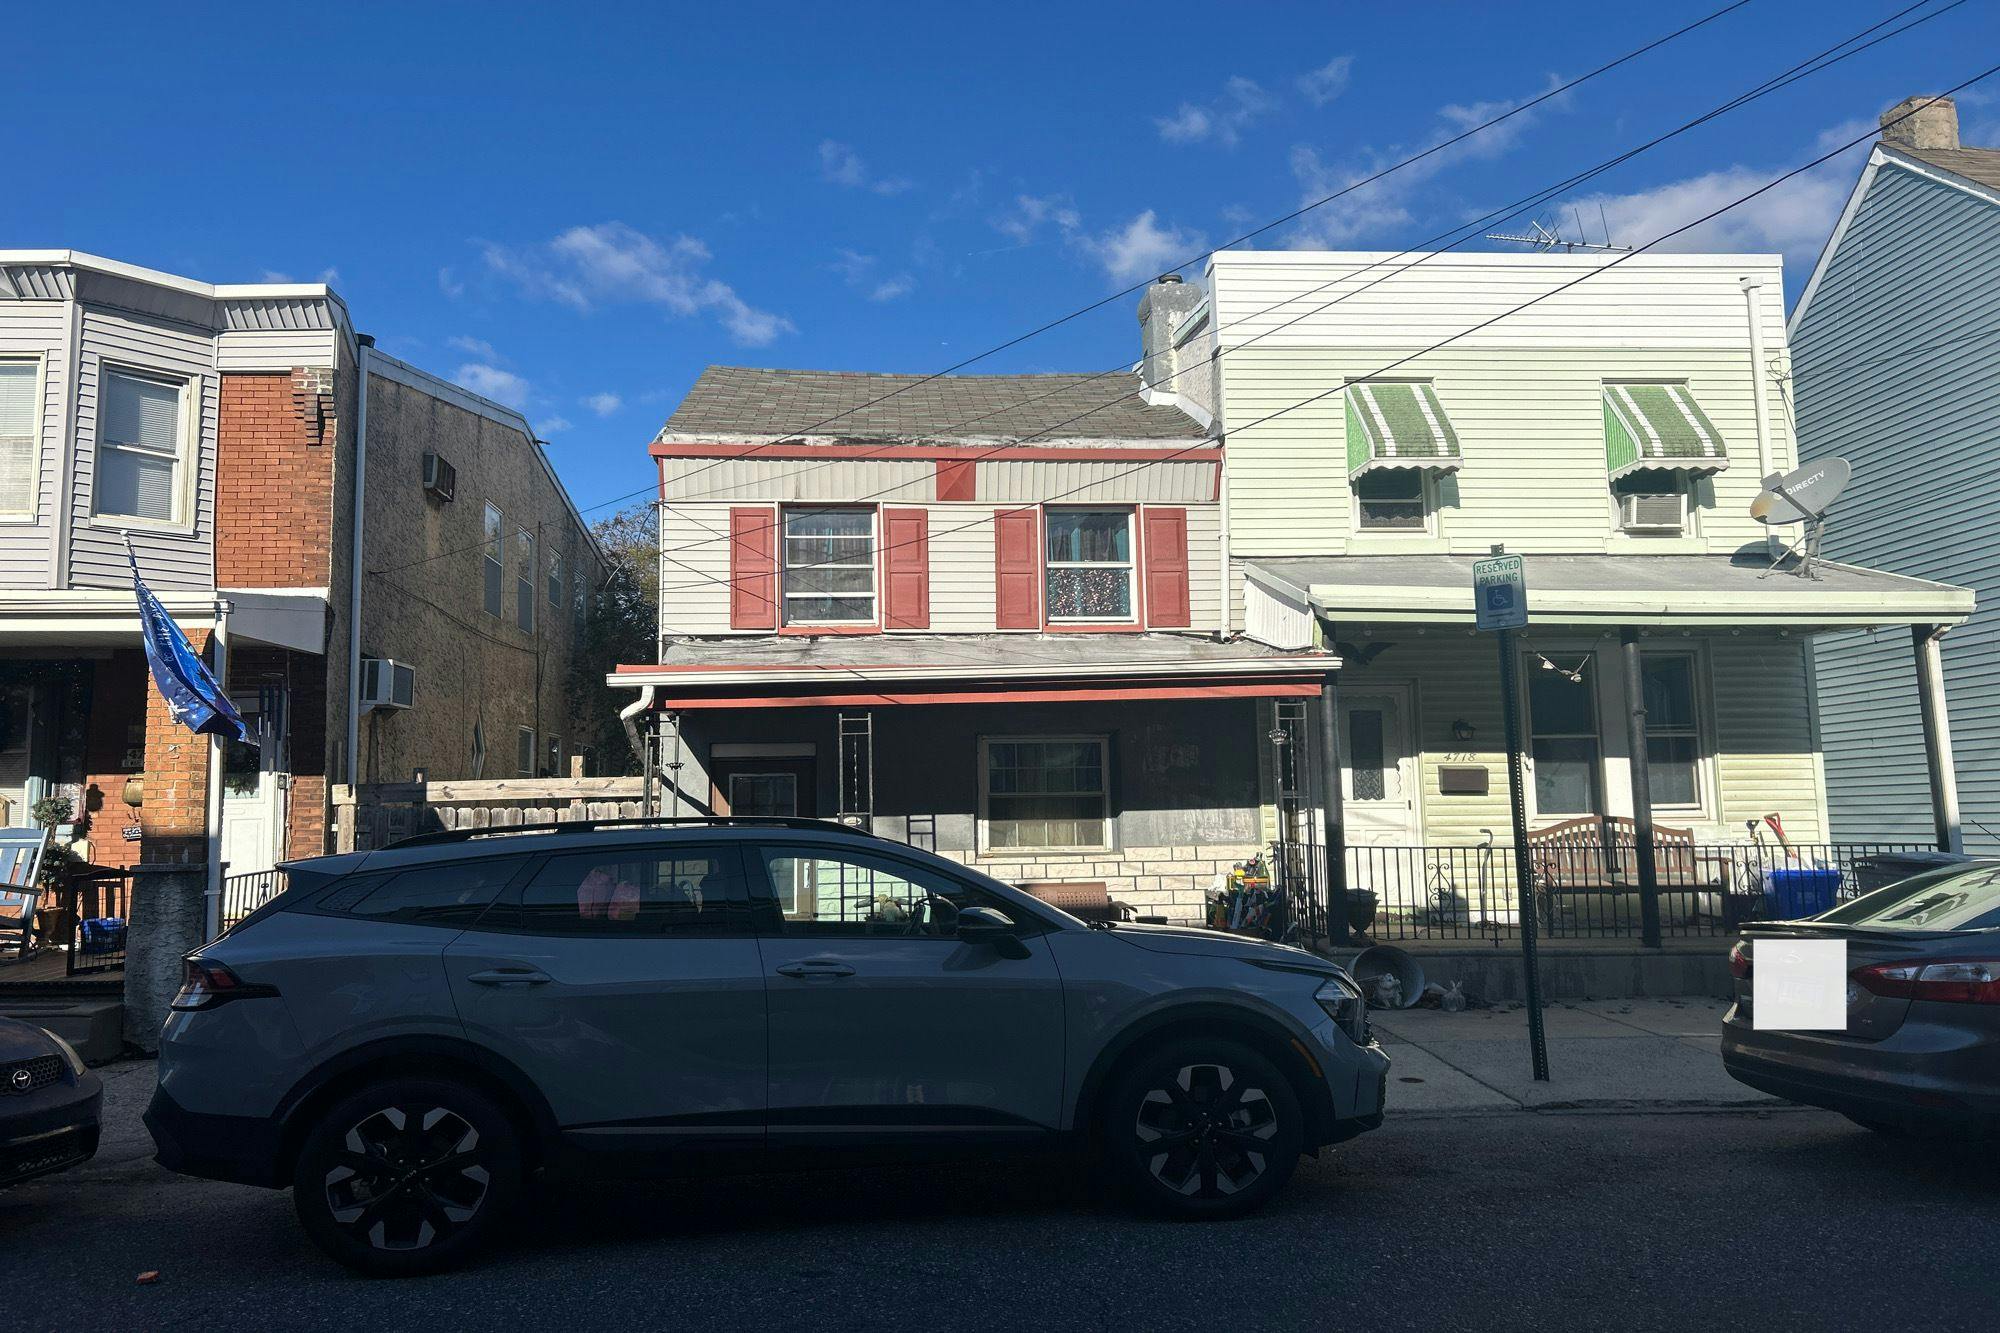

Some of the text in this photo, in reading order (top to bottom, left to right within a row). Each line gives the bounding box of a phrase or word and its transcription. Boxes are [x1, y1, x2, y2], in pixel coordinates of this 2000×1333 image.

[1785, 470, 1825, 495] DIRECTV
[1476, 560, 1519, 574] RESERVED
[1480, 572, 1518, 585] PARKING
[1443, 752, 1477, 762] 4718
